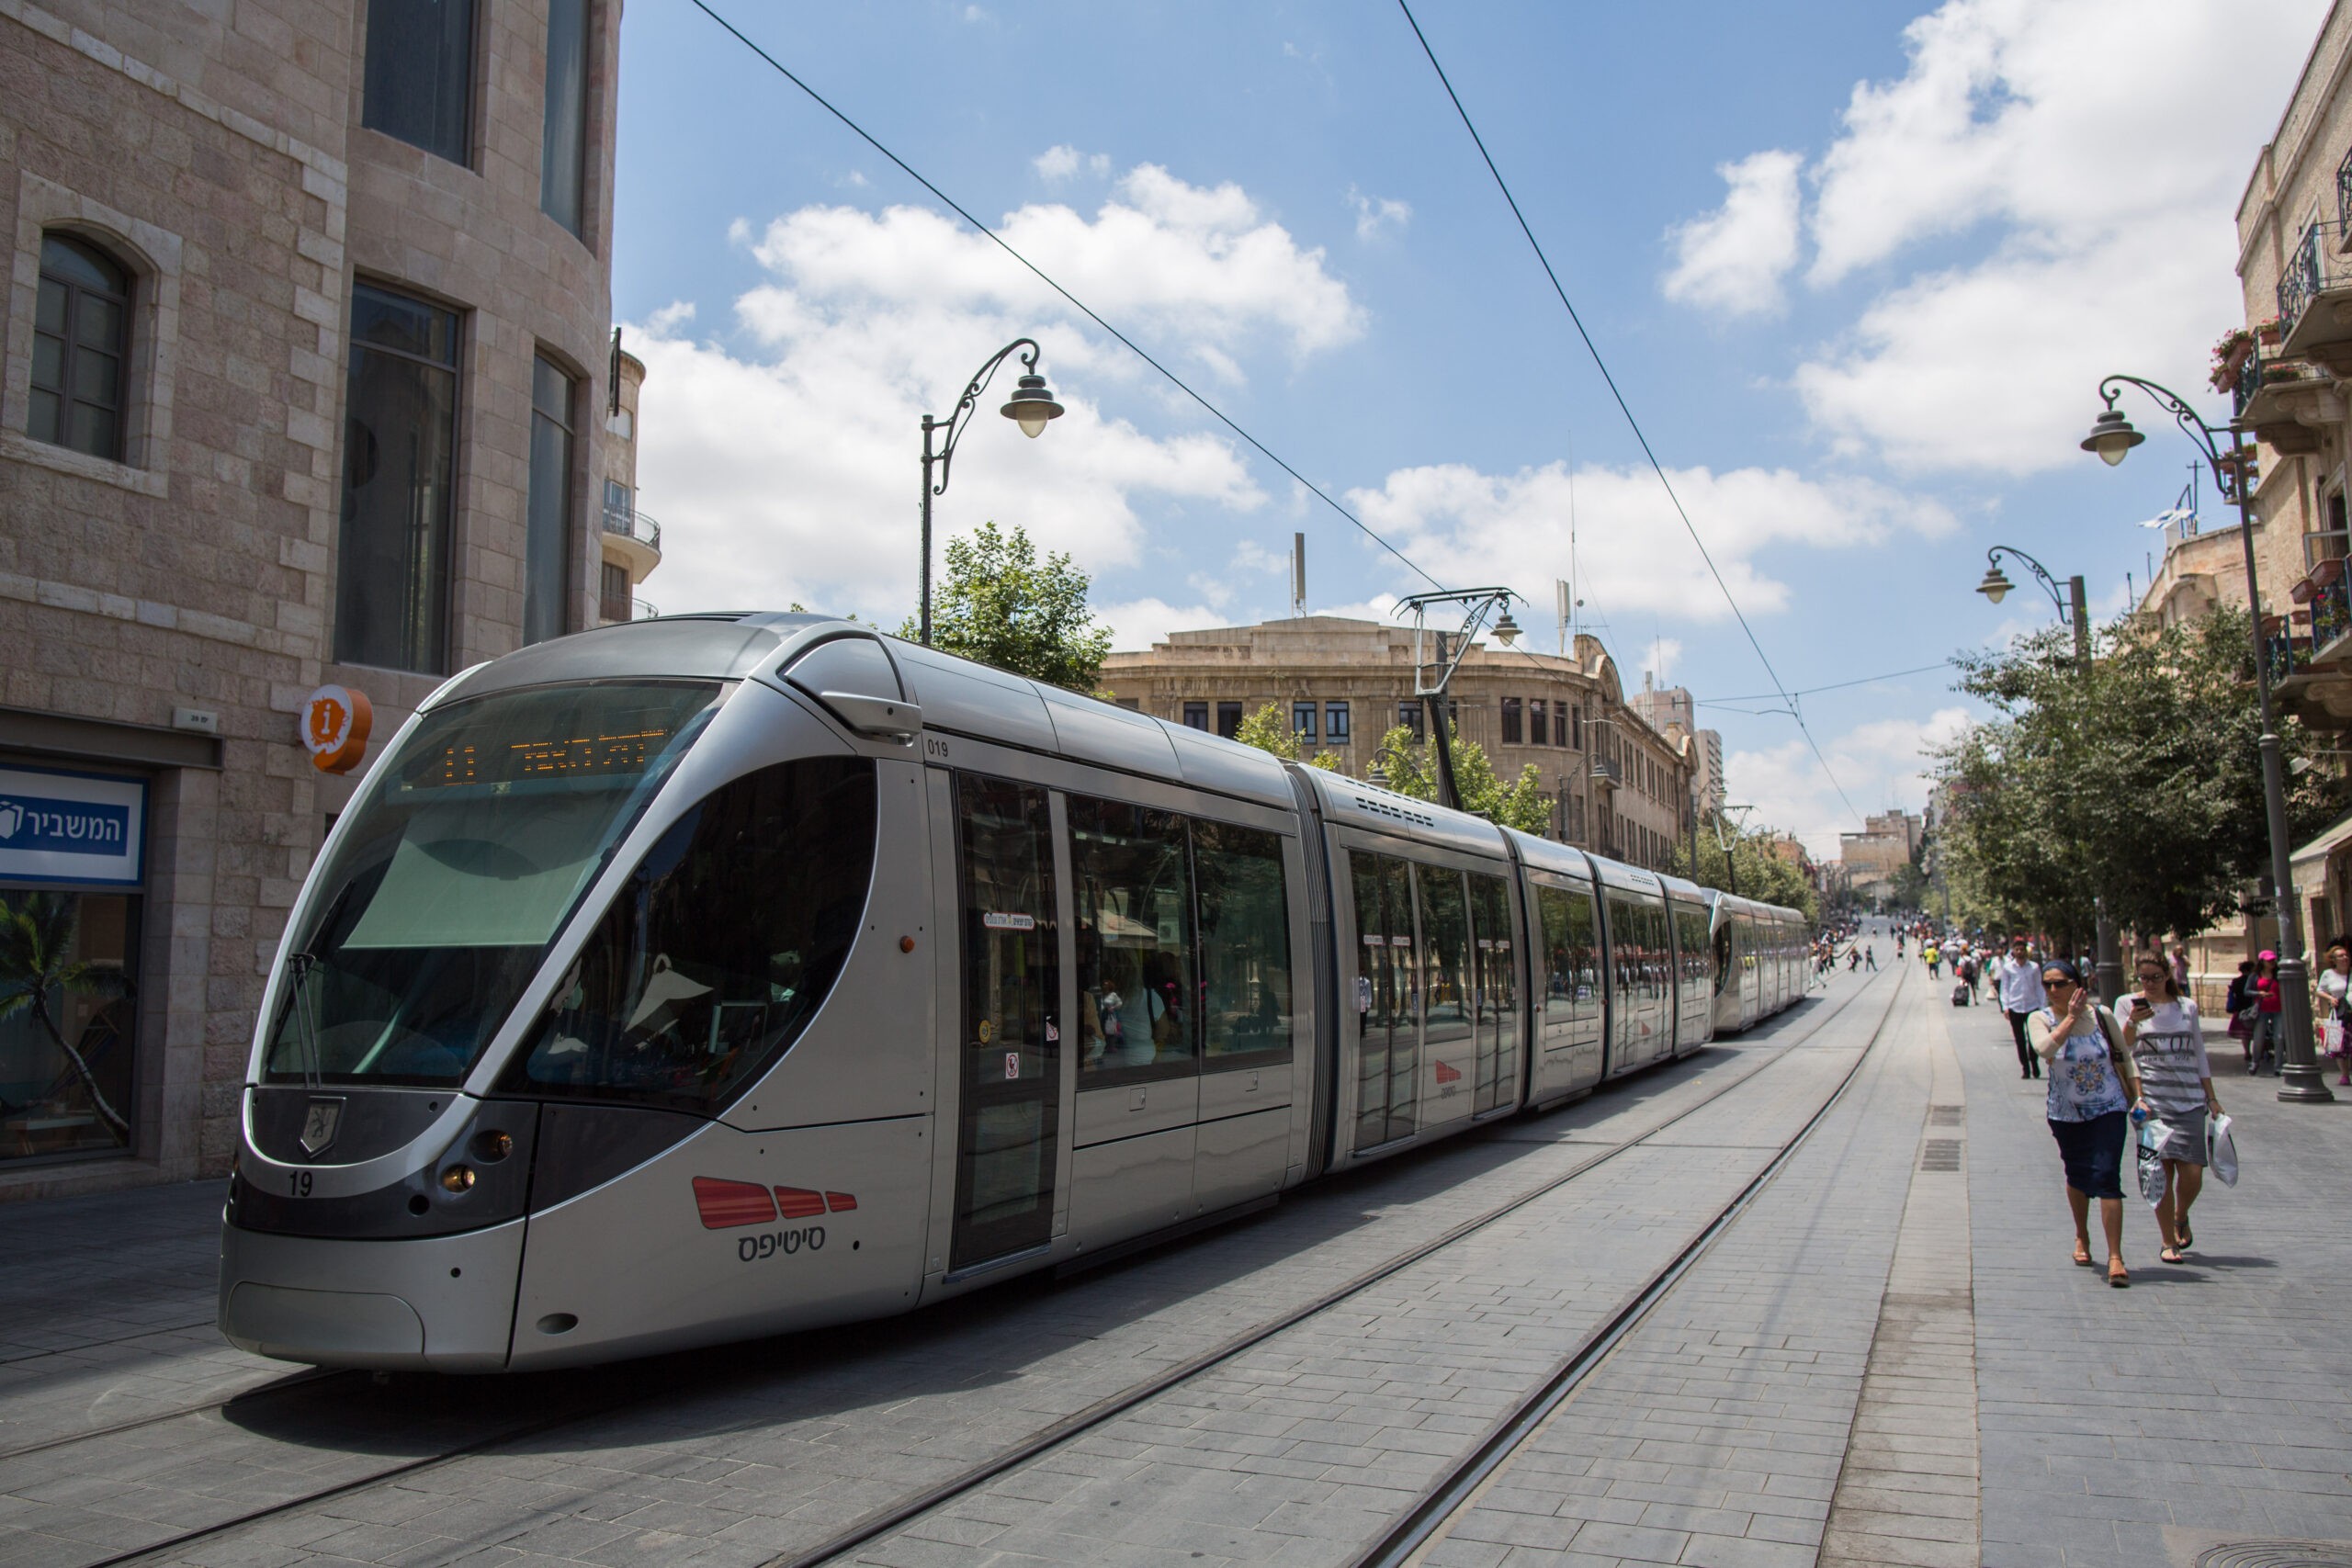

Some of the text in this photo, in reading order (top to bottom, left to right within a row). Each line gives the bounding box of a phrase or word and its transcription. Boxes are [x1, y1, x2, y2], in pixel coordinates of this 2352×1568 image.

[928, 739, 948, 758] 019
[27, 811, 121, 842] המשביר
[289, 1170, 312, 1198] 19
[738, 1226, 826, 1262] סיטיפס
